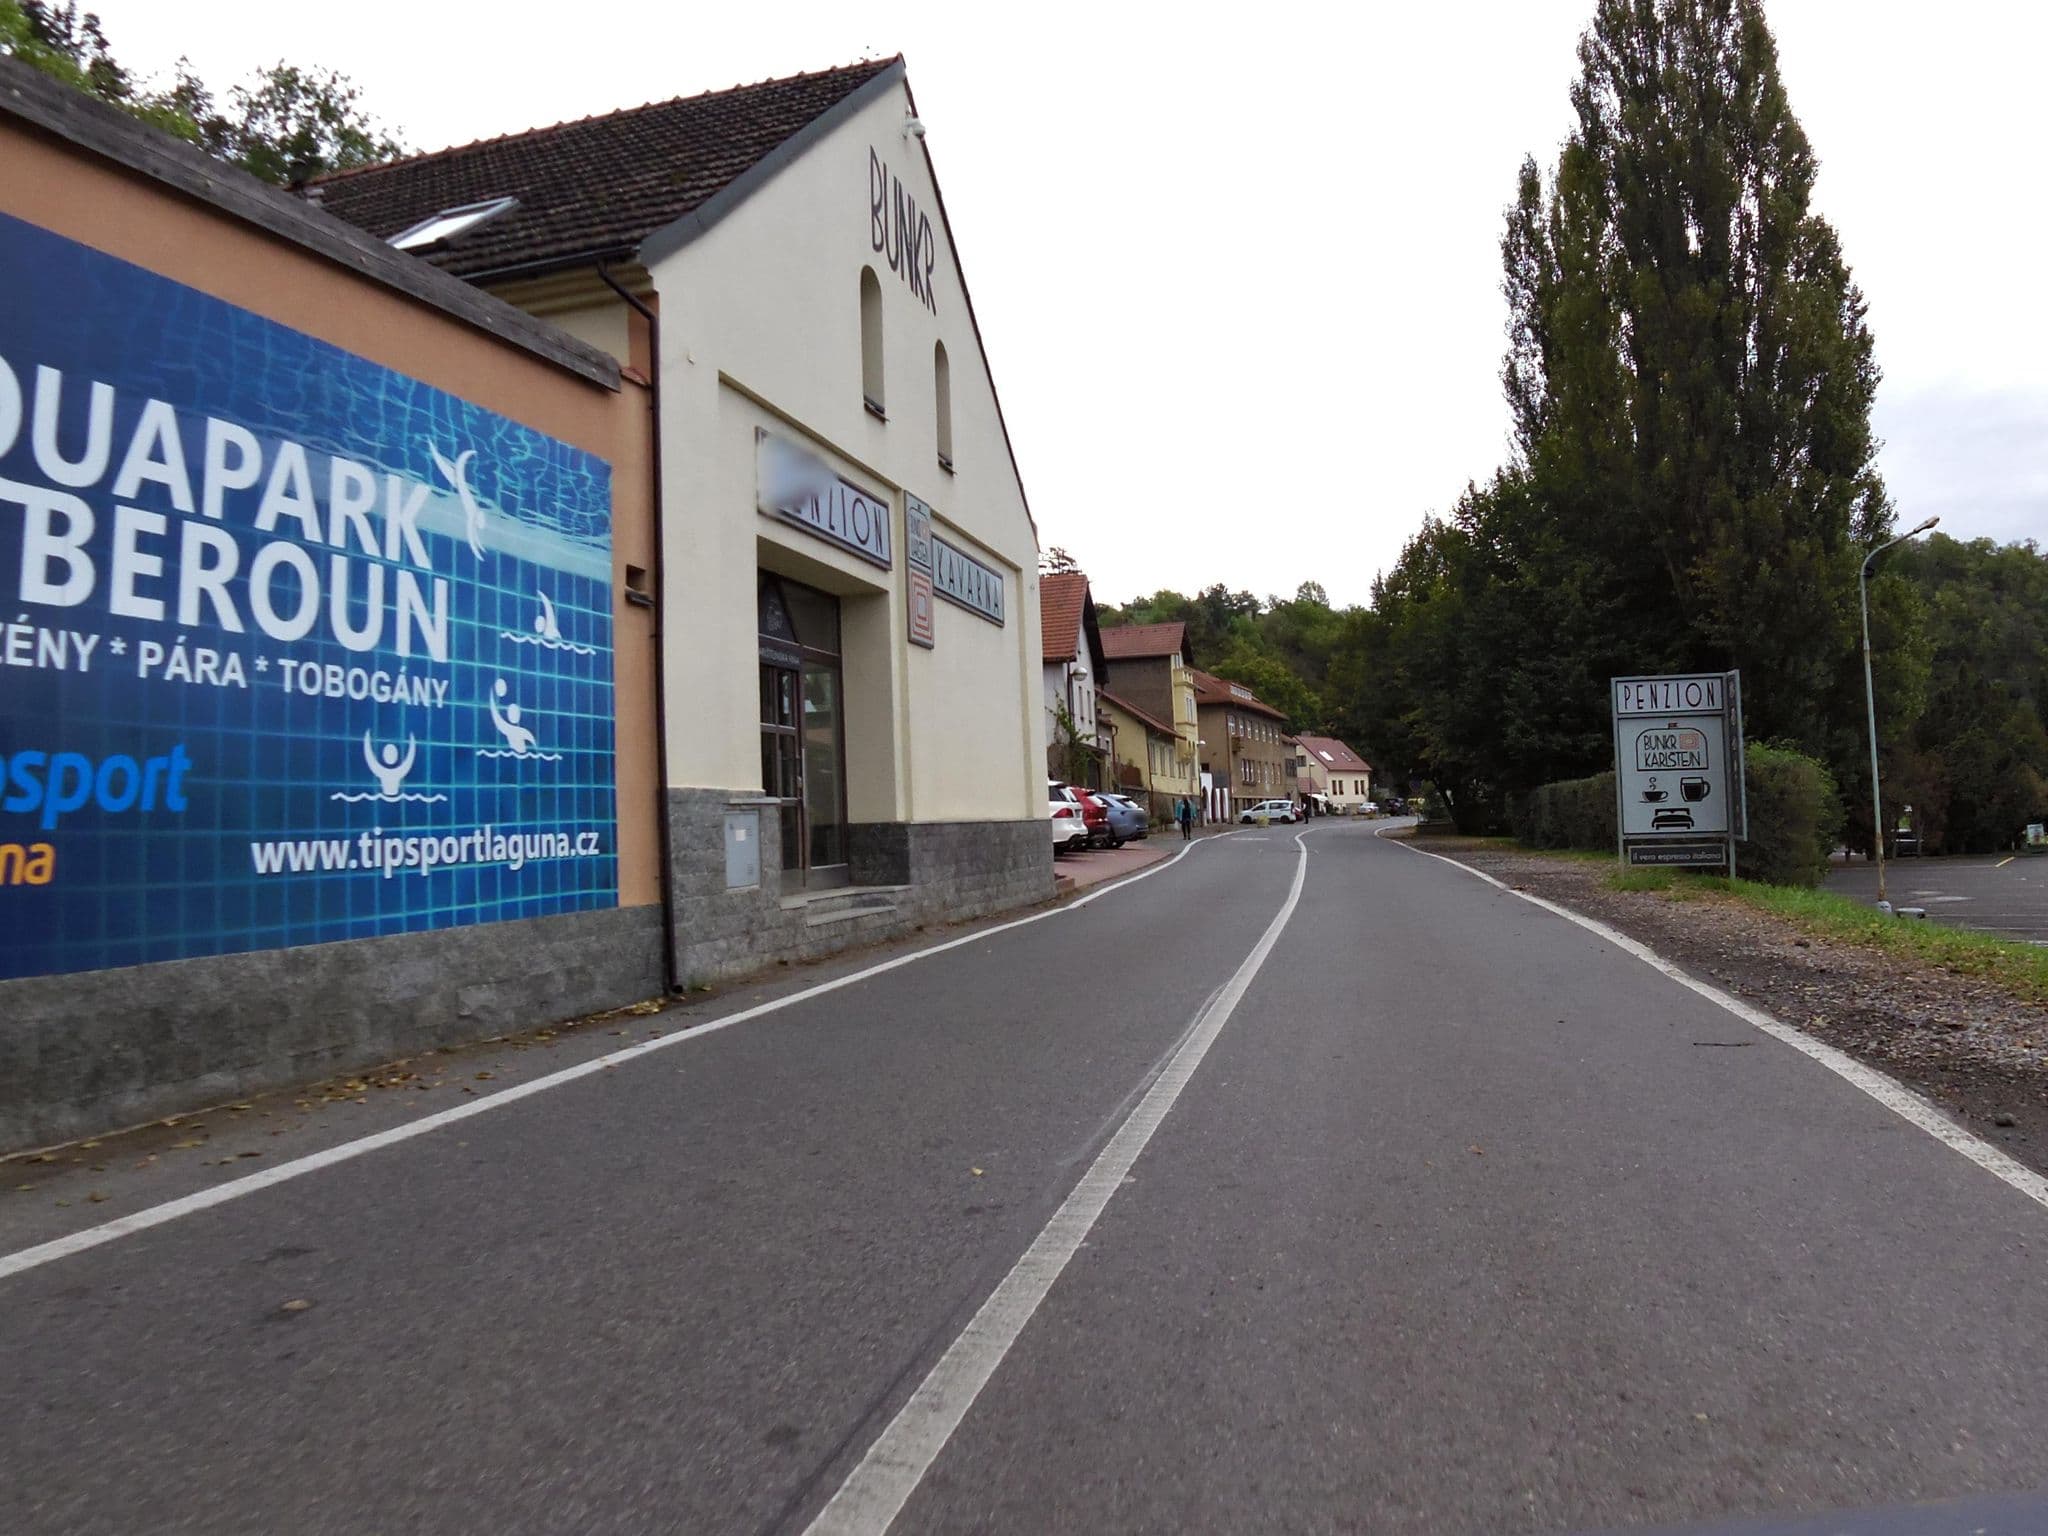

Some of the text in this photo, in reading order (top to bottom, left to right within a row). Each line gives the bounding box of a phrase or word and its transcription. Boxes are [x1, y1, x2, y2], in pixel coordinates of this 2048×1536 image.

[870, 144, 936, 316] BUNKR
[19, 486, 449, 663] BEROUN
[0, 614, 448, 708] ÉNY PÁRA TOBOGÁNY
[1624, 682, 1715, 710] PENZION
[1643, 734, 1677, 751] BUNKR
[0, 743, 193, 830] sport
[251, 824, 600, 879] www.tipsportlaguna.cz
